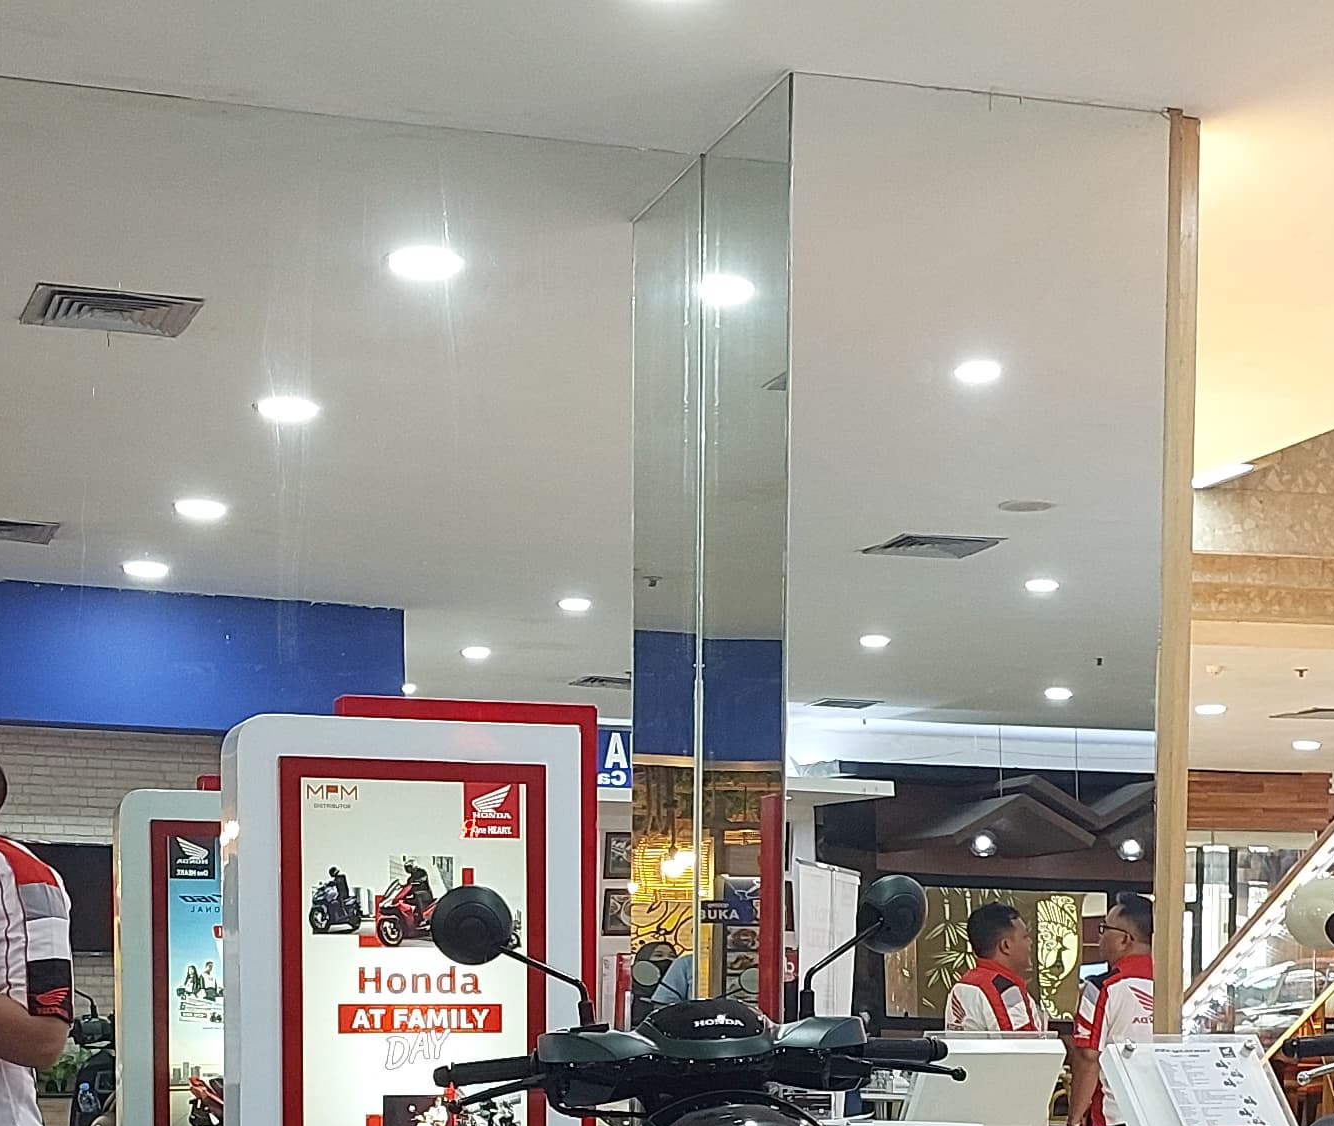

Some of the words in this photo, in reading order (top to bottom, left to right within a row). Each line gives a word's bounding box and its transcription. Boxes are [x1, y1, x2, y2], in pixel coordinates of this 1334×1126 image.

[306, 784, 358, 801] MPM
[472, 811, 512, 820] HONDA
[358, 966, 483, 995] Honda
[351, 1008, 387, 1030] AT
[392, 1007, 491, 1030] FAMILY
[693, 1015, 746, 1028] HONDA
[384, 1028, 452, 1071] DAY
